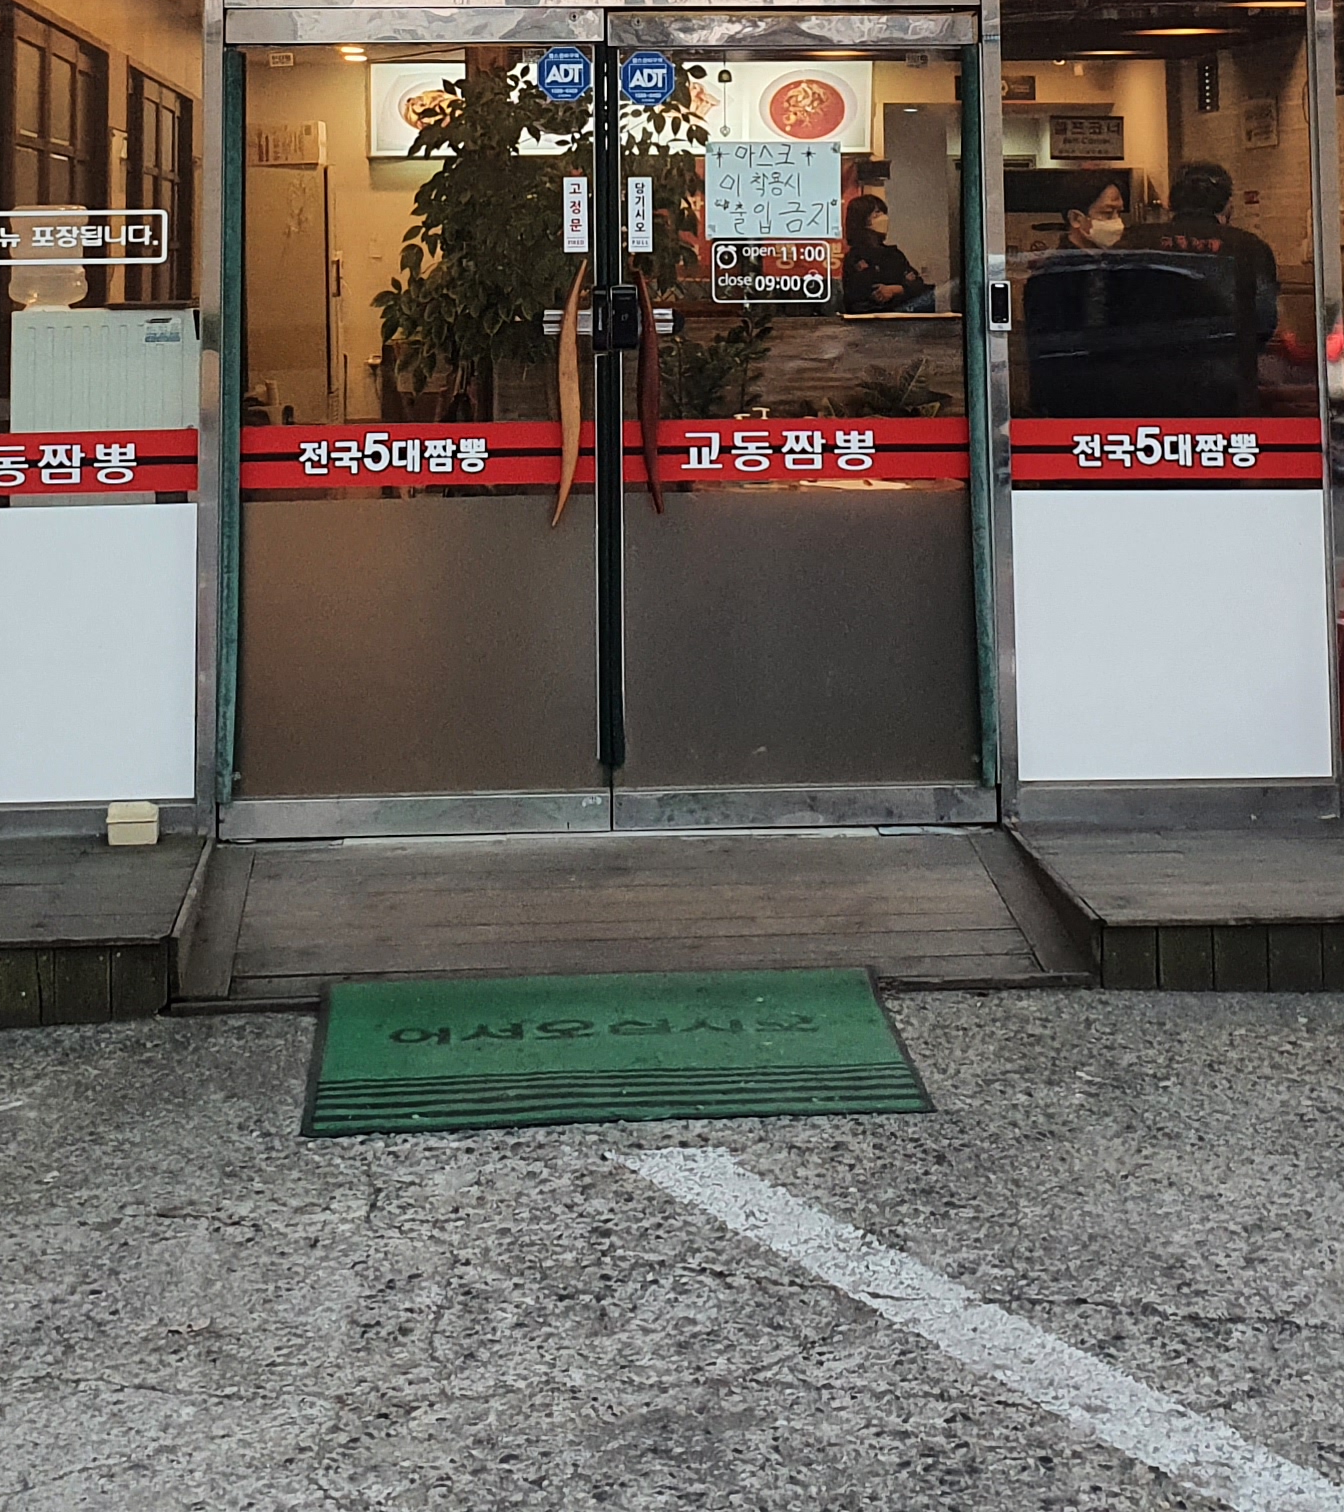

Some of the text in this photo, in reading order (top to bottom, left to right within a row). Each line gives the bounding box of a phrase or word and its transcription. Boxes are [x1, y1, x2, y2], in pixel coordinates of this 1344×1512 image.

[545, 63, 584, 84] ADT
[629, 68, 667, 88] ADT
[734, 143, 796, 169] 마스크
[750, 171, 802, 198] 착용시
[568, 182, 584, 233] 고정문
[633, 182, 647, 233] 당기시오
[31, 225, 159, 249] 포장됩니다.
[742, 245, 777, 258] open
[780, 245, 827, 263] 11:00
[718, 272, 802, 292] close 09:00
[298, 432, 489, 475] 전국5대짬뽕
[681, 430, 876, 472] 교동짬뽕
[1072, 426, 1260, 468] 전국5대짬뽕
